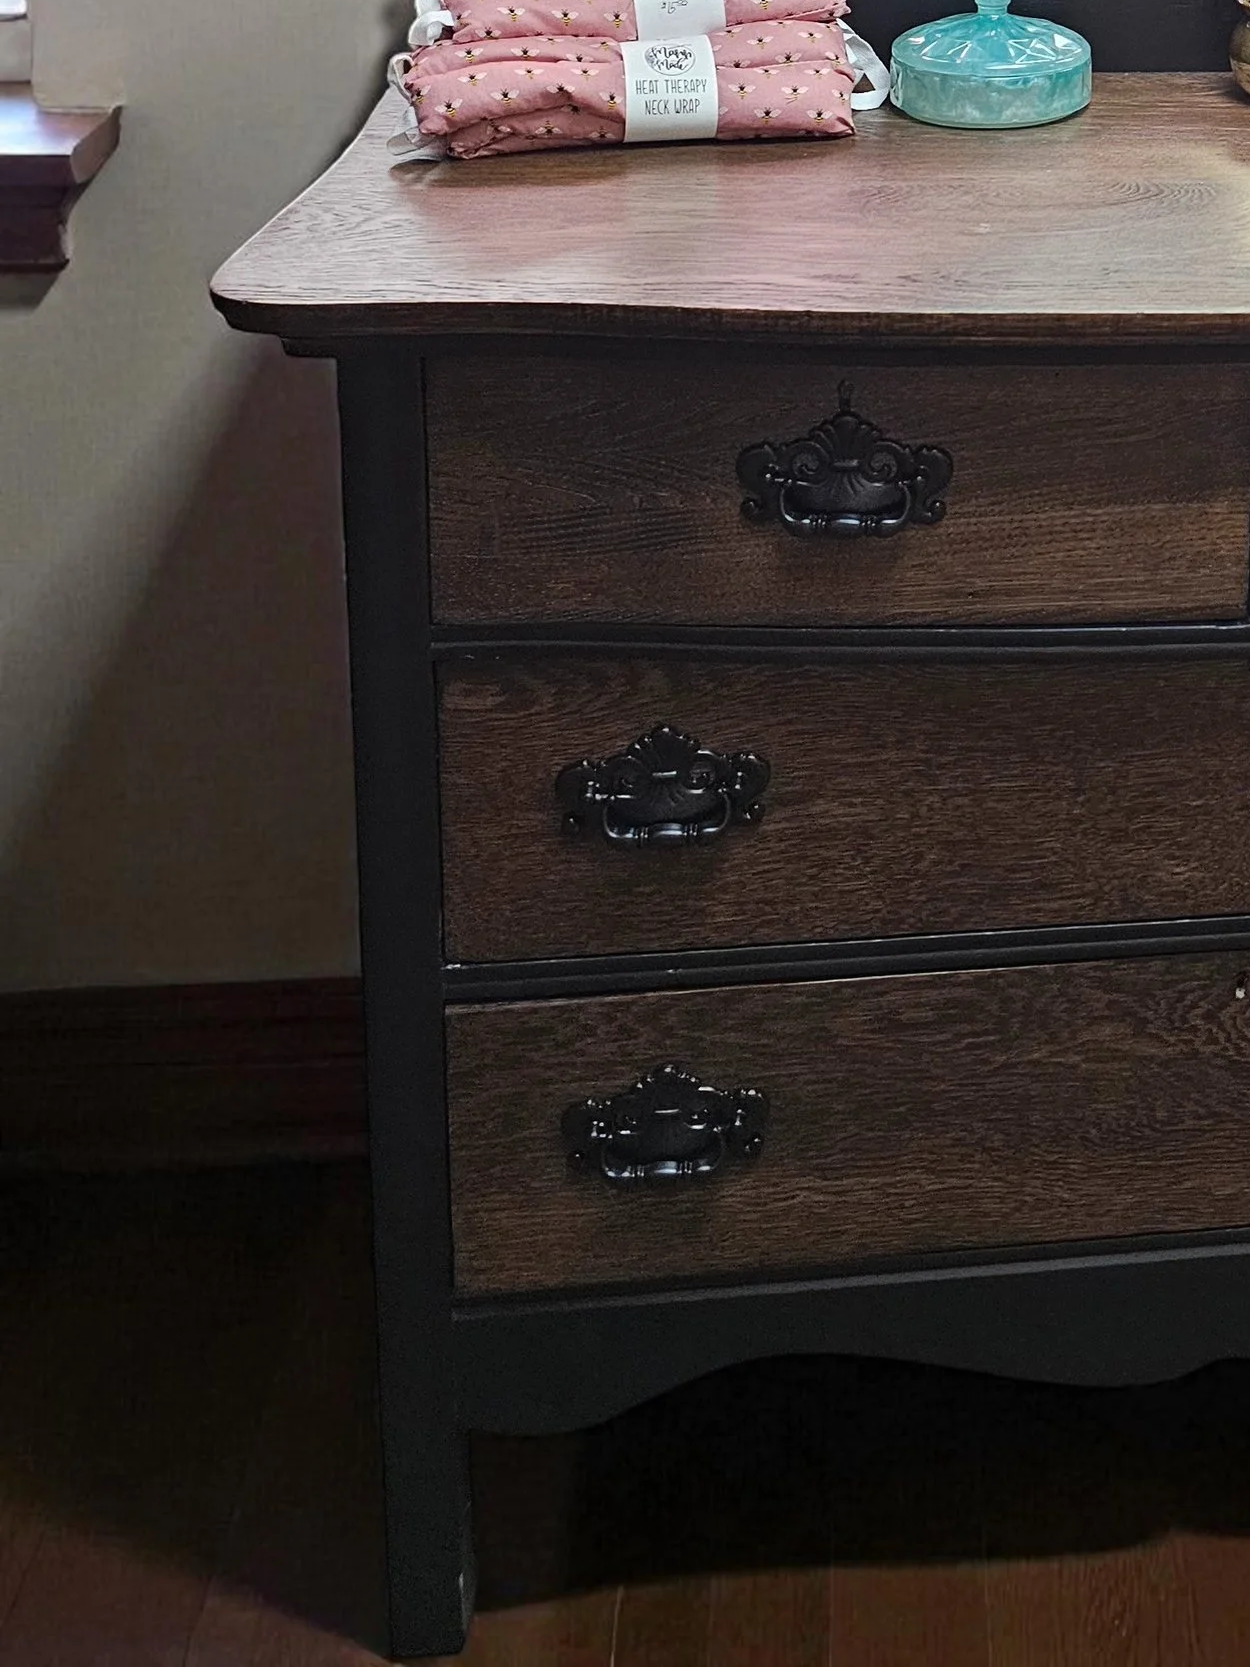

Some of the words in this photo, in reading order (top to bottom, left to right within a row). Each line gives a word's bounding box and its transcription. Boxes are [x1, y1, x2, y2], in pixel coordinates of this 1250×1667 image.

[635, 79, 659, 94] HEAT
[664, 78, 707, 94] THERAPY
[644, 98, 670, 115] NECK
[674, 98, 701, 114] WRAP
